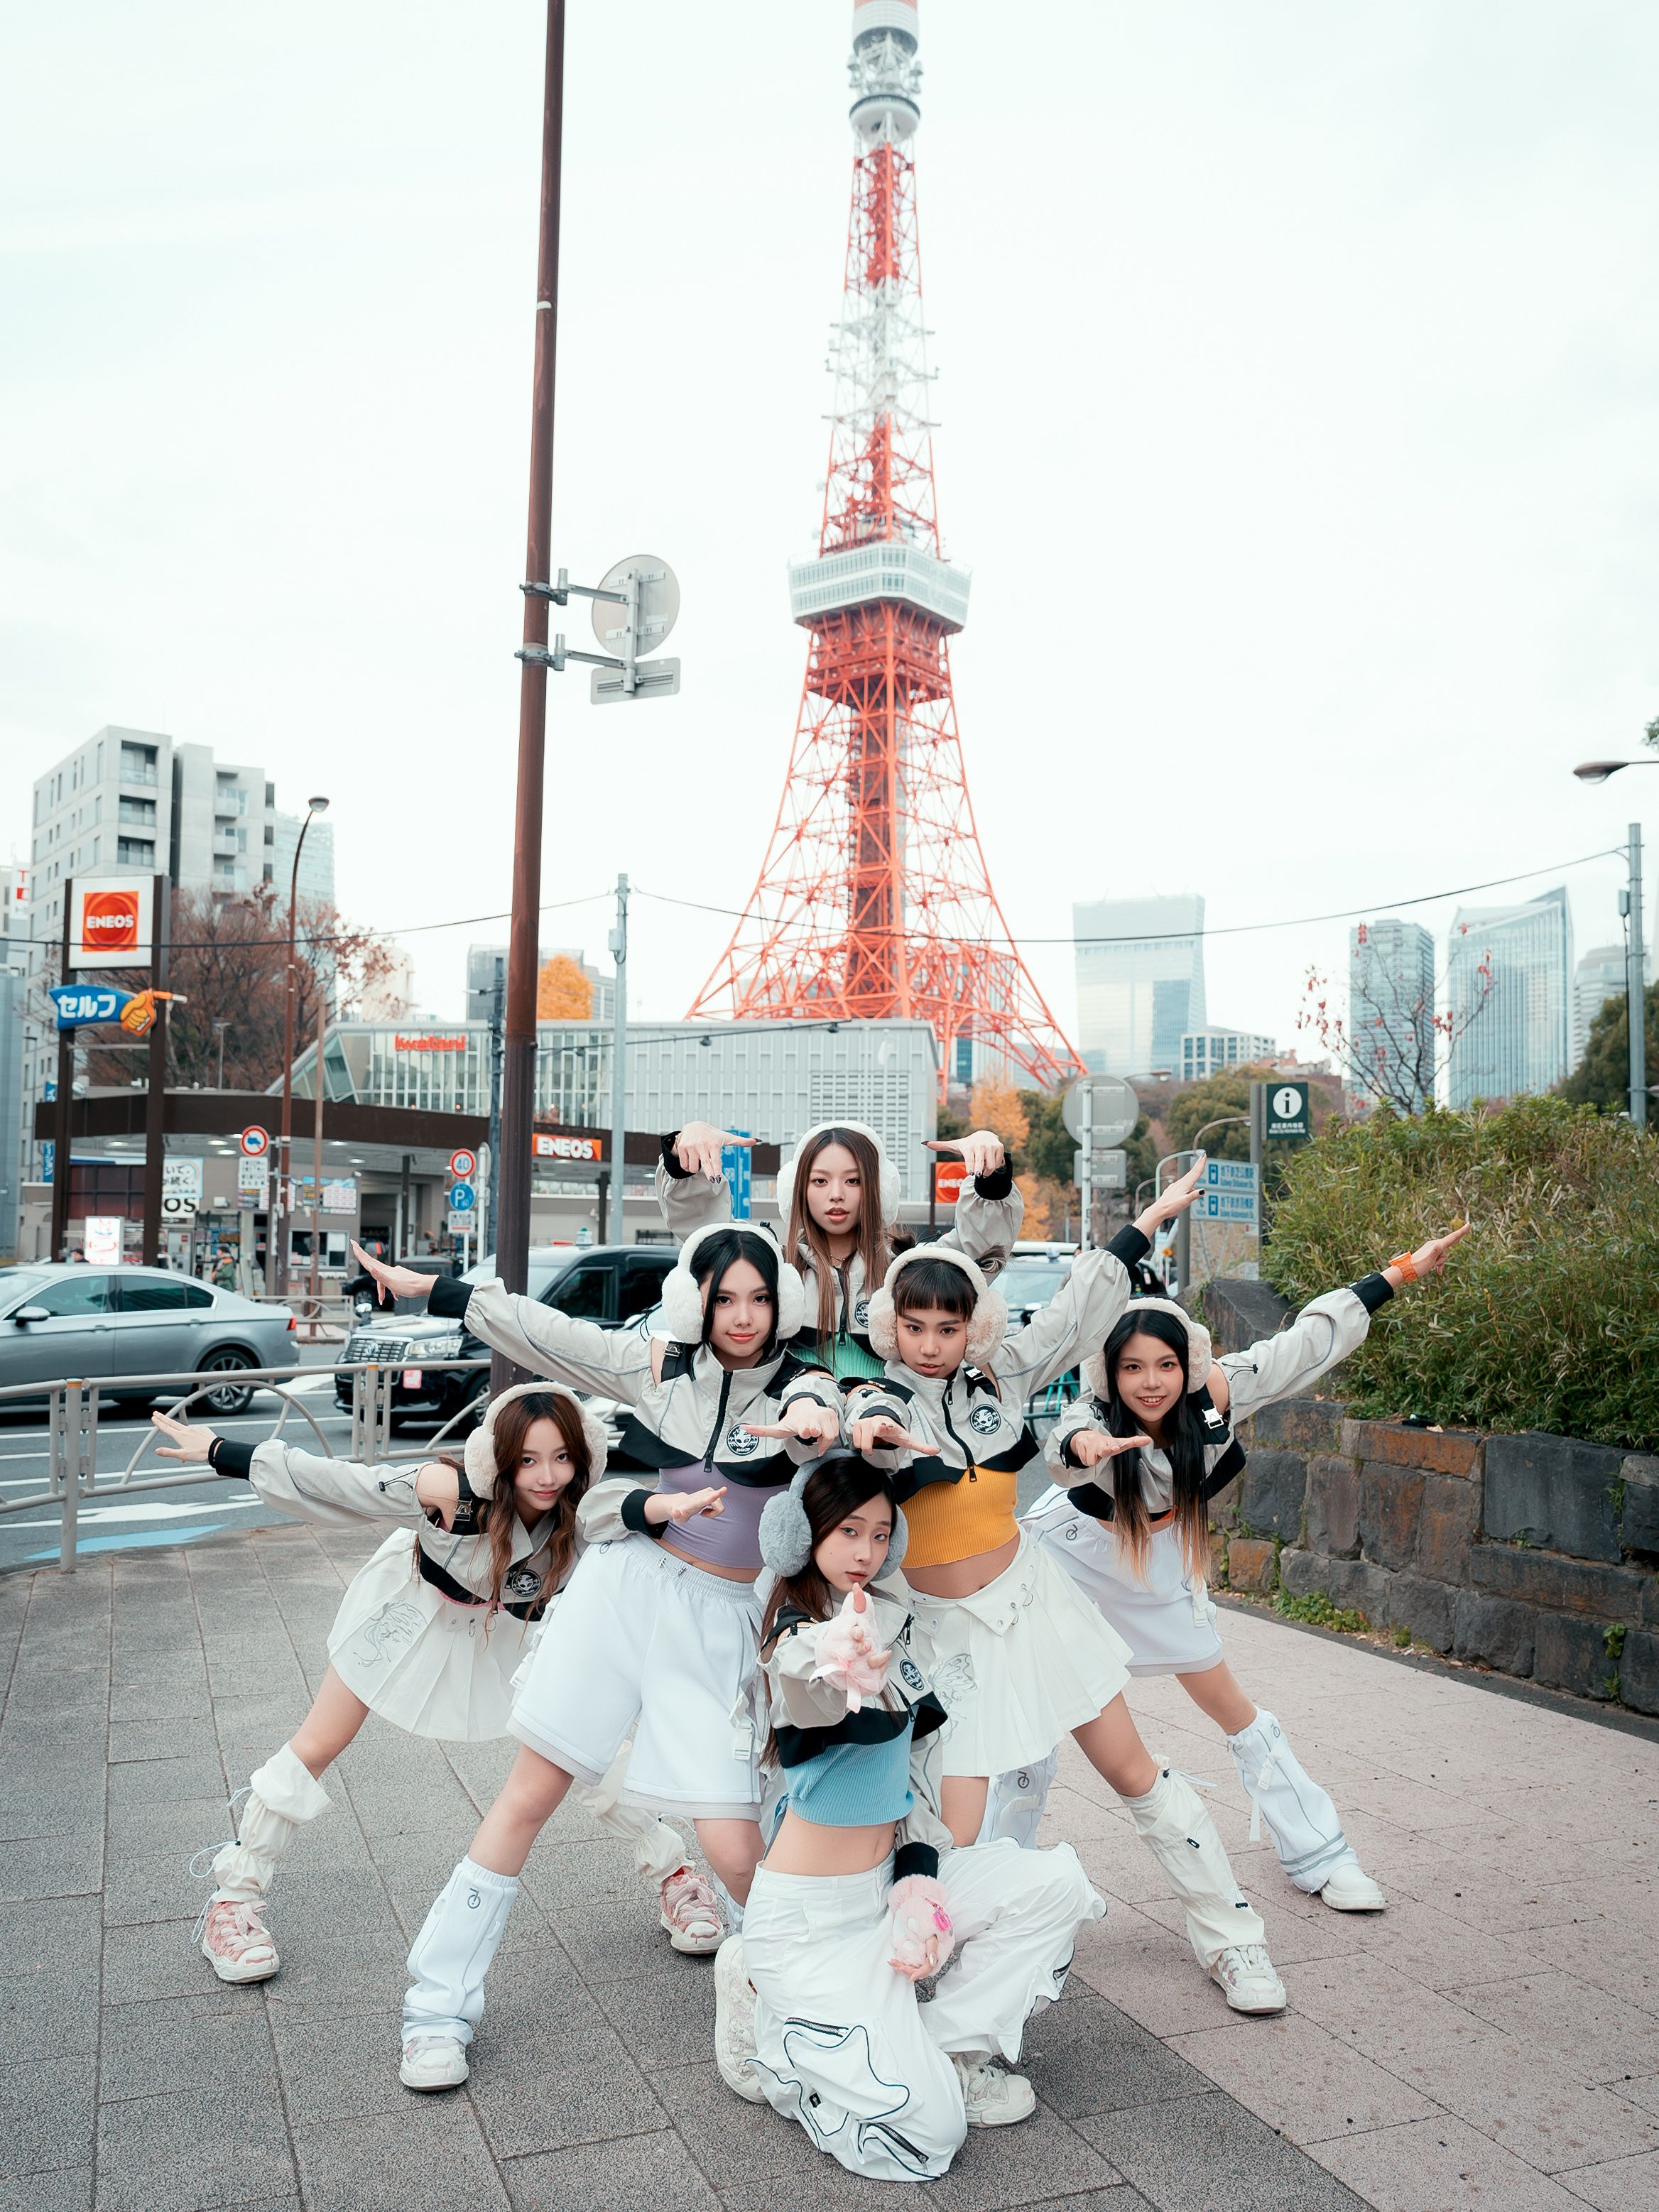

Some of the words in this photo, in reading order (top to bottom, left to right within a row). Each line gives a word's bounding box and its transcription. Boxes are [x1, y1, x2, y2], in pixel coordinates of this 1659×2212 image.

[86, 914, 134, 929] ENEOS
[58, 994, 116, 1018] セルフ
[395, 1034, 466, 1051] Iwatani
[537, 1135, 593, 1160] ENEOS
[456, 1157, 469, 1170] 40
[455, 1189, 465, 1207] P
